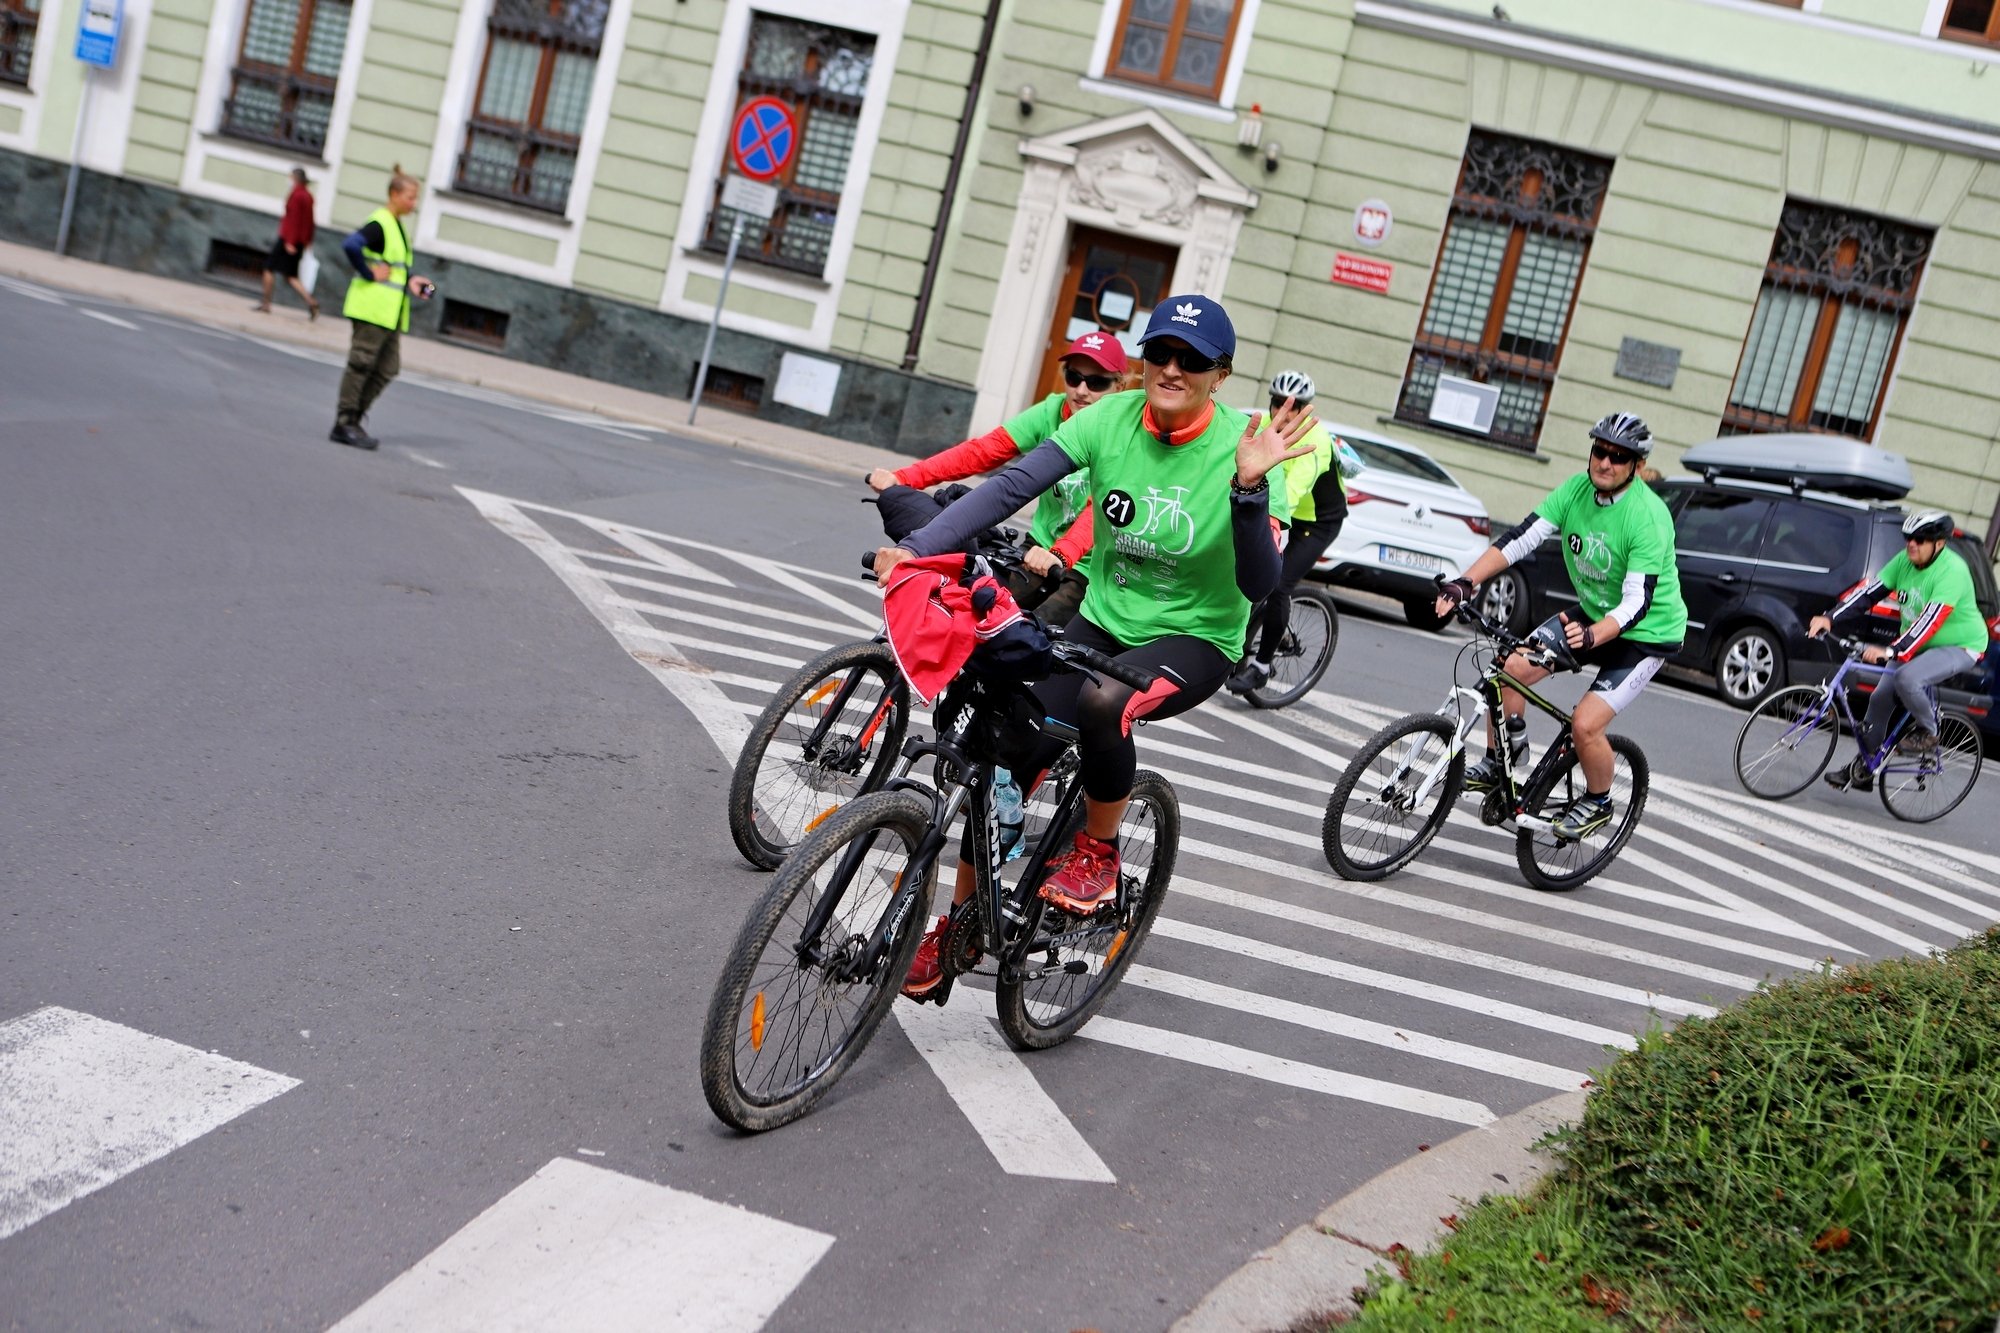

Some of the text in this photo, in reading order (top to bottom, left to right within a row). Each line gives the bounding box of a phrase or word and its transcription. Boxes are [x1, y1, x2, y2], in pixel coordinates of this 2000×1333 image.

[1171, 315, 1198, 327] adidas
[1106, 493, 1131, 523] 21
[1571, 535, 1580, 553] 21
[1049, 931, 1089, 949] GIANT
